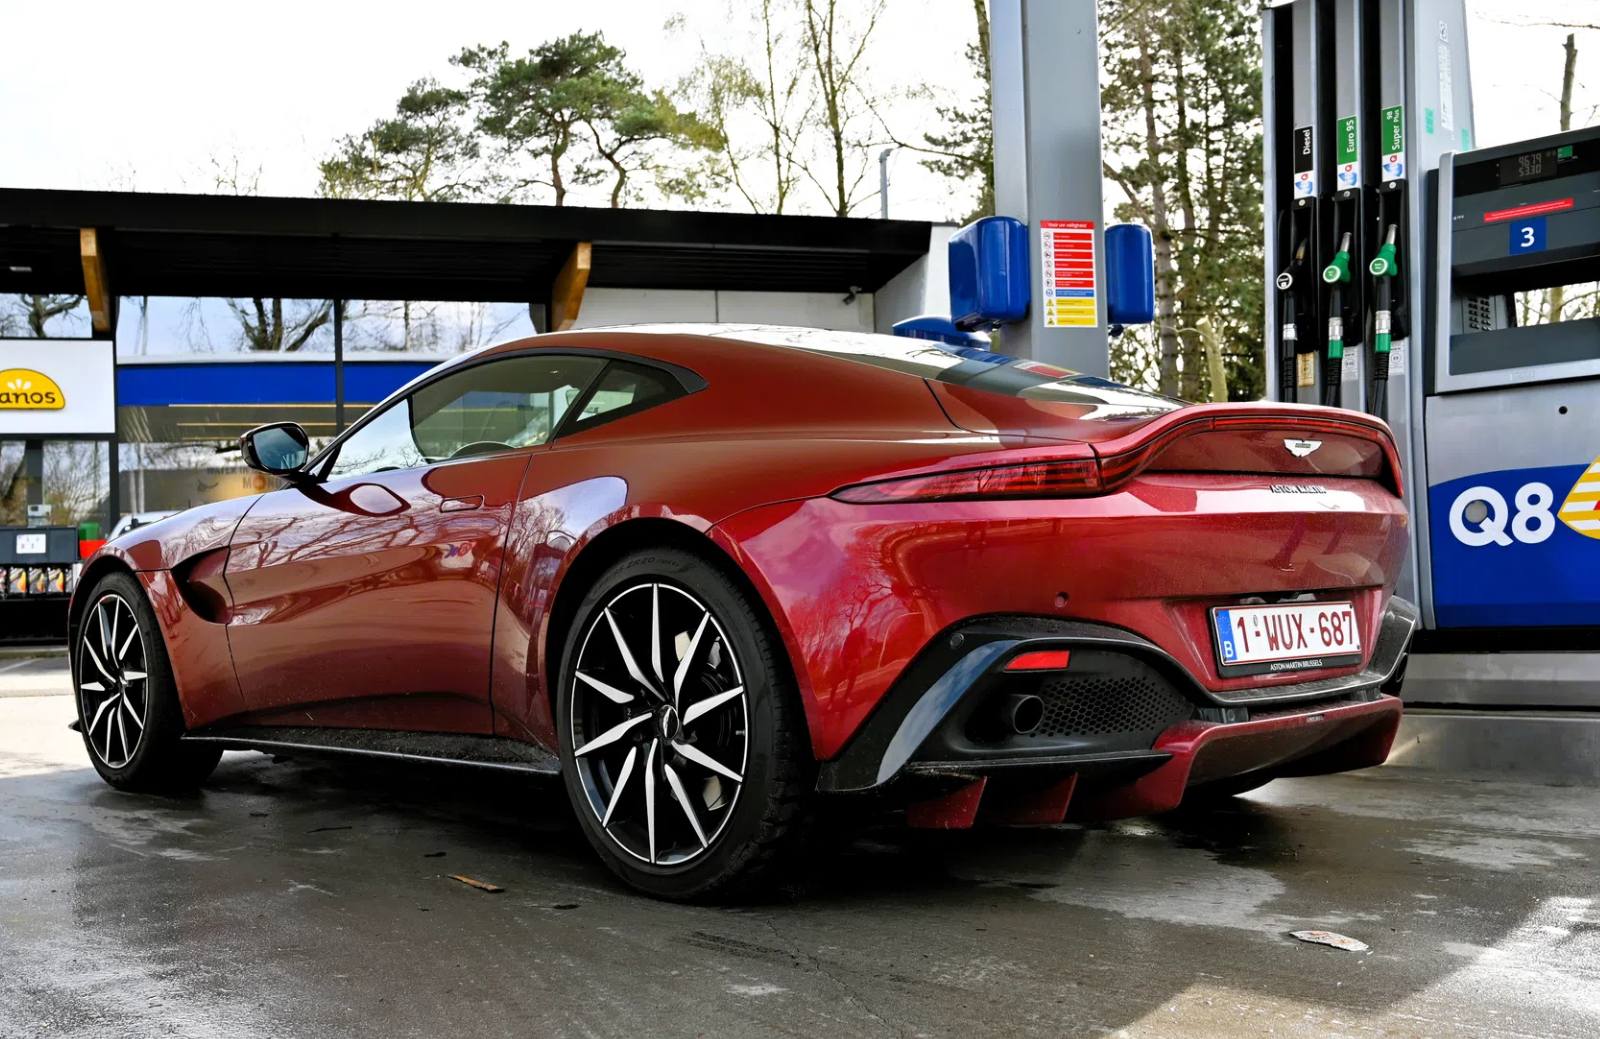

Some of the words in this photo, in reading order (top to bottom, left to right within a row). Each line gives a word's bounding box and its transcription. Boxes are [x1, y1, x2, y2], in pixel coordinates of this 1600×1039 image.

[1346, 119, 1355, 132] 95
[1302, 129, 1311, 155] Diesel
[1346, 132, 1355, 153] Euro
[1391, 125, 1401, 151] Super
[1520, 226, 1535, 248] 3
[1448, 481, 1556, 547] Q8
[1223, 640, 1234, 658] B
[1270, 663, 1286, 671] ASTON
[1286, 661, 1303, 669] MARTIN
